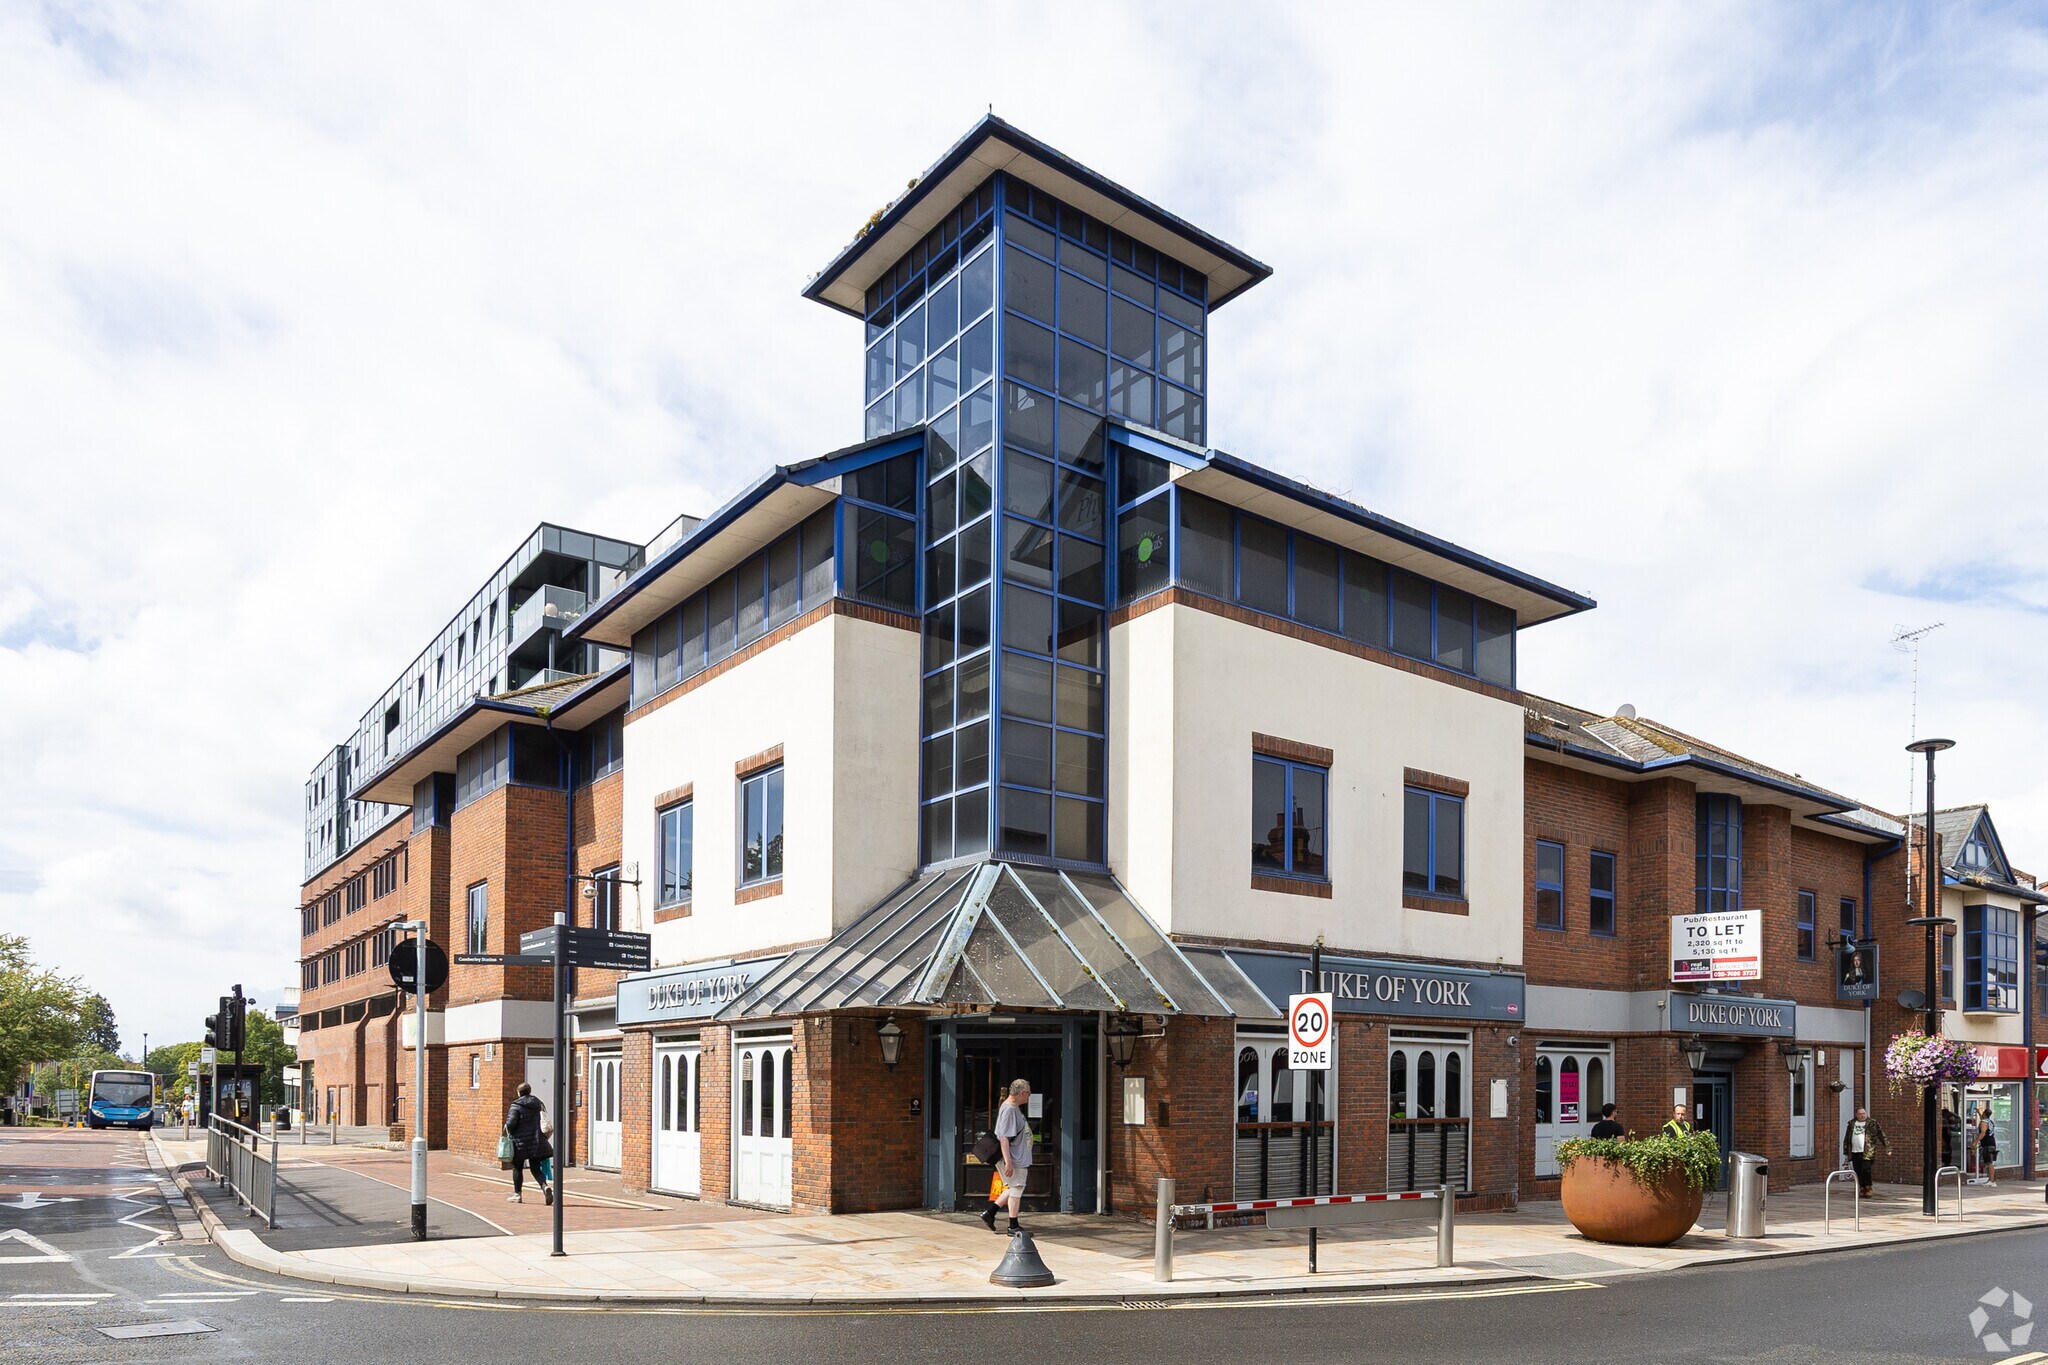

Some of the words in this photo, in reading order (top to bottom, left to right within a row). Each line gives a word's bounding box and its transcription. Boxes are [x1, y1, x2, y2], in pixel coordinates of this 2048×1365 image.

[1684, 914, 1748, 923] Pub/Restaurant
[1686, 926, 1708, 938] TO
[1715, 924, 1744, 936] LET
[648, 982, 684, 1010] DUKE
[686, 980, 704, 1006] OF
[708, 974, 750, 1004] YORK
[1300, 969, 1370, 1000] DUKE
[1375, 975, 1406, 1002] OF
[1410, 978, 1472, 1006] YORK
[1298, 1012, 1322, 1032] 20
[1689, 1003, 1726, 1024] DUKE
[1729, 1006, 1746, 1025] OF
[1748, 1007, 1782, 1027] YORK
[1293, 1052, 1326, 1063] ZONE
